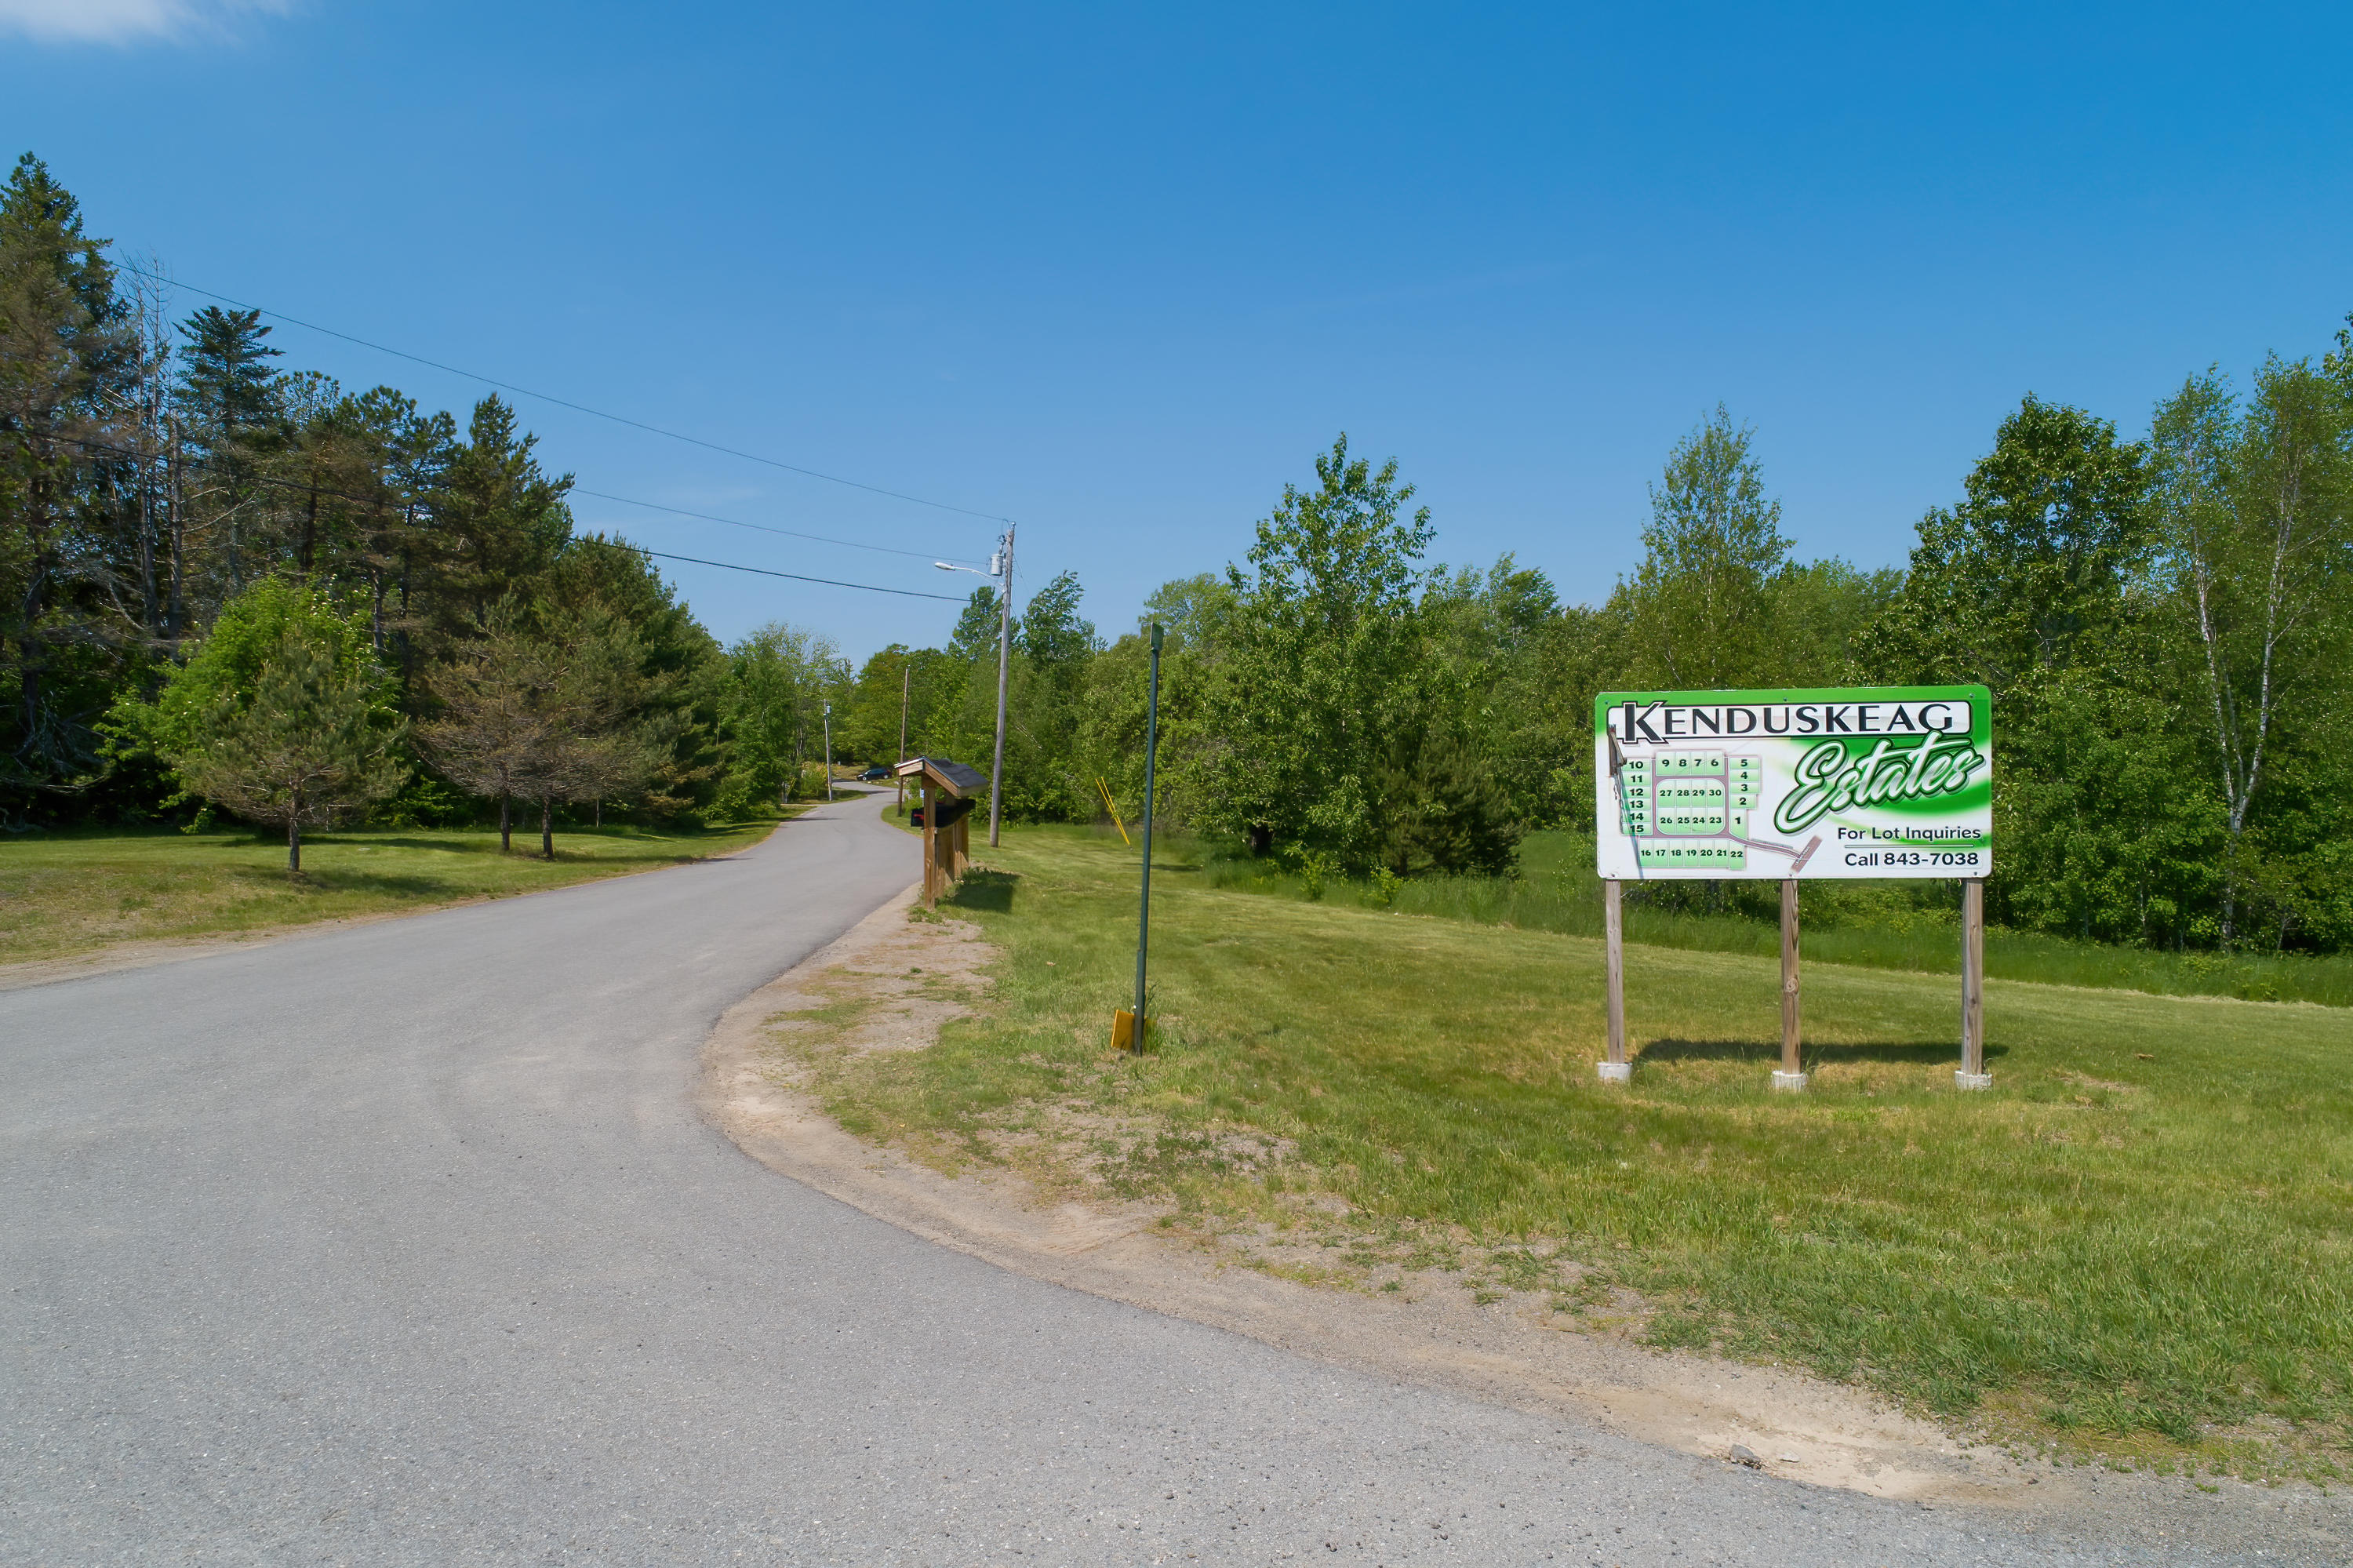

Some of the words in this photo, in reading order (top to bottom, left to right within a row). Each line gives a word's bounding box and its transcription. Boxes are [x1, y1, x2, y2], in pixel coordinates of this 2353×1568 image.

[1622, 700, 1953, 744] KENDUSKEAG
[1629, 761, 1644, 769] 10
[1774, 730, 1984, 834] Estates
[1630, 800, 1644, 809] 13
[1739, 797, 1747, 806] 2
[1630, 813, 1644, 821] 14
[1630, 824, 1644, 833] 15
[1838, 828, 1866, 839] For
[1872, 828, 1900, 839] Lot
[1906, 826, 1981, 842] Inquiries
[1845, 853, 1878, 866] Call
[1884, 853, 1979, 866] 843-7038
